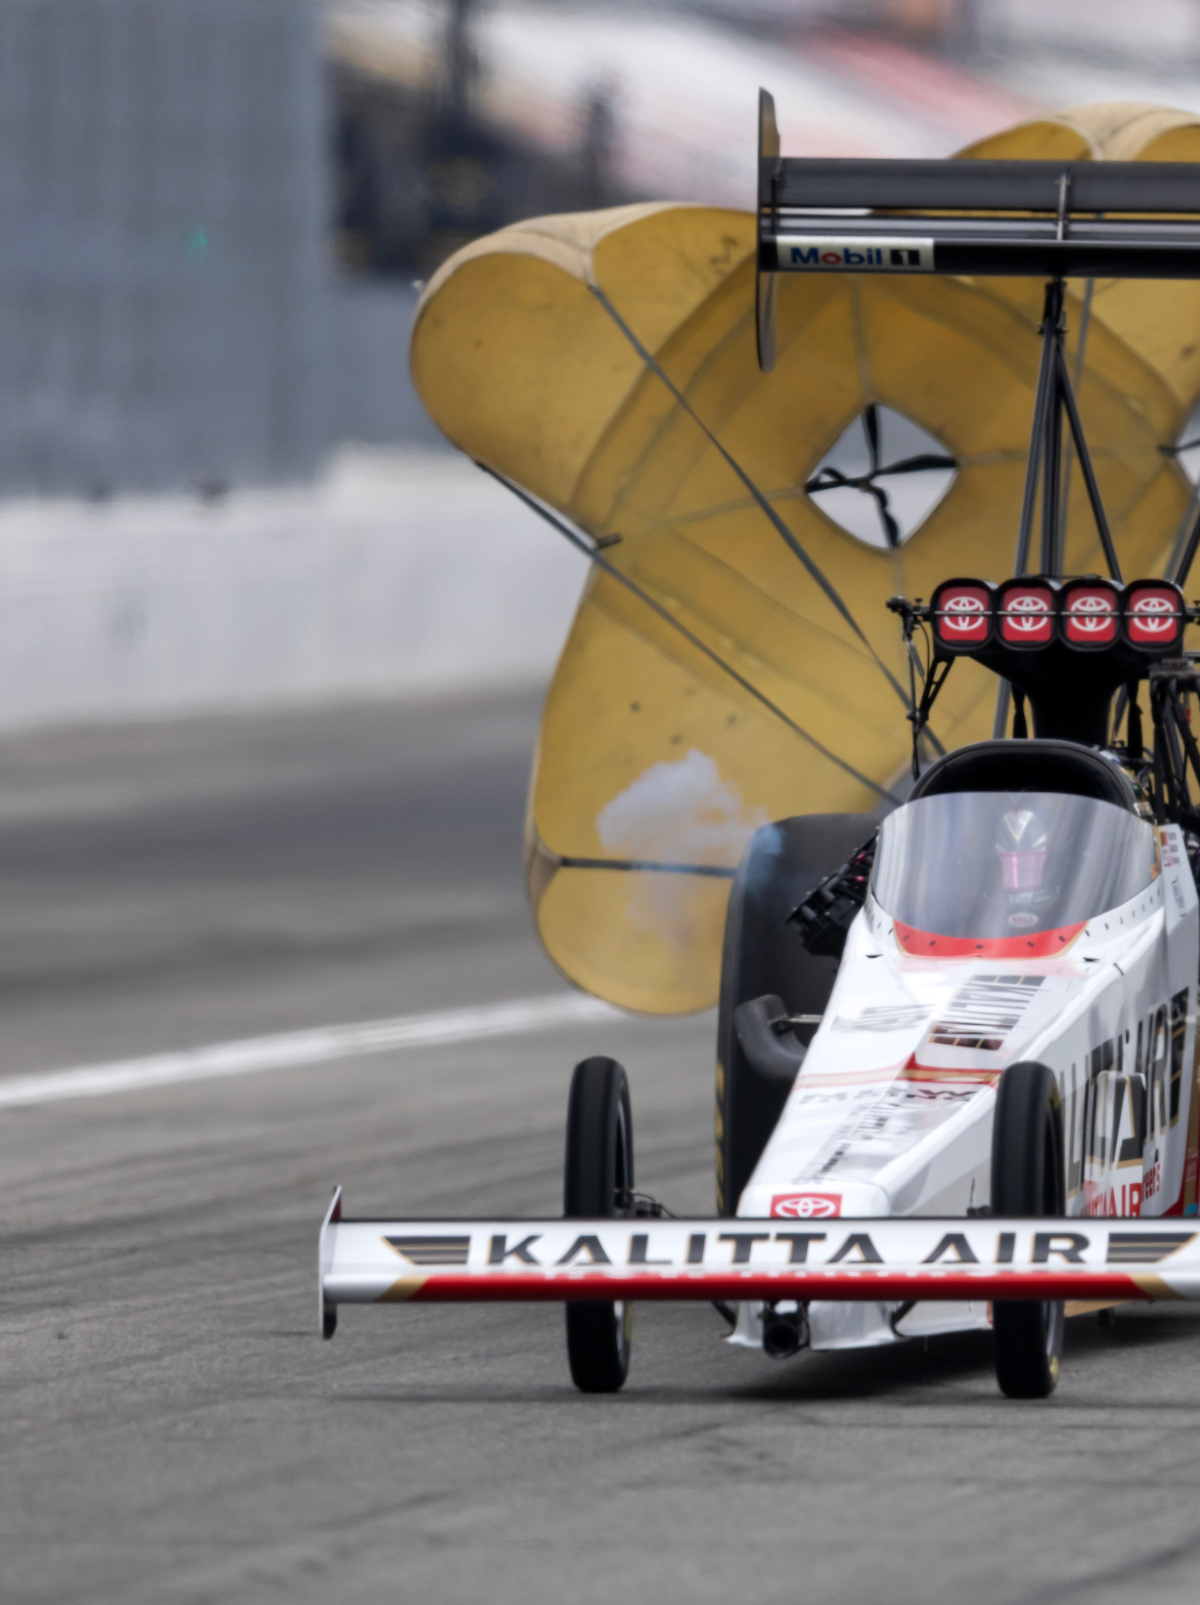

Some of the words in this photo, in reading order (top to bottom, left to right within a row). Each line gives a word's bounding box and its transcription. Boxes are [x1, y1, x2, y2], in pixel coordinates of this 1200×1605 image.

[790, 247, 883, 265] Mobil
[487, 1232, 885, 1265] KALITTA
[920, 1232, 1090, 1264] AIR
